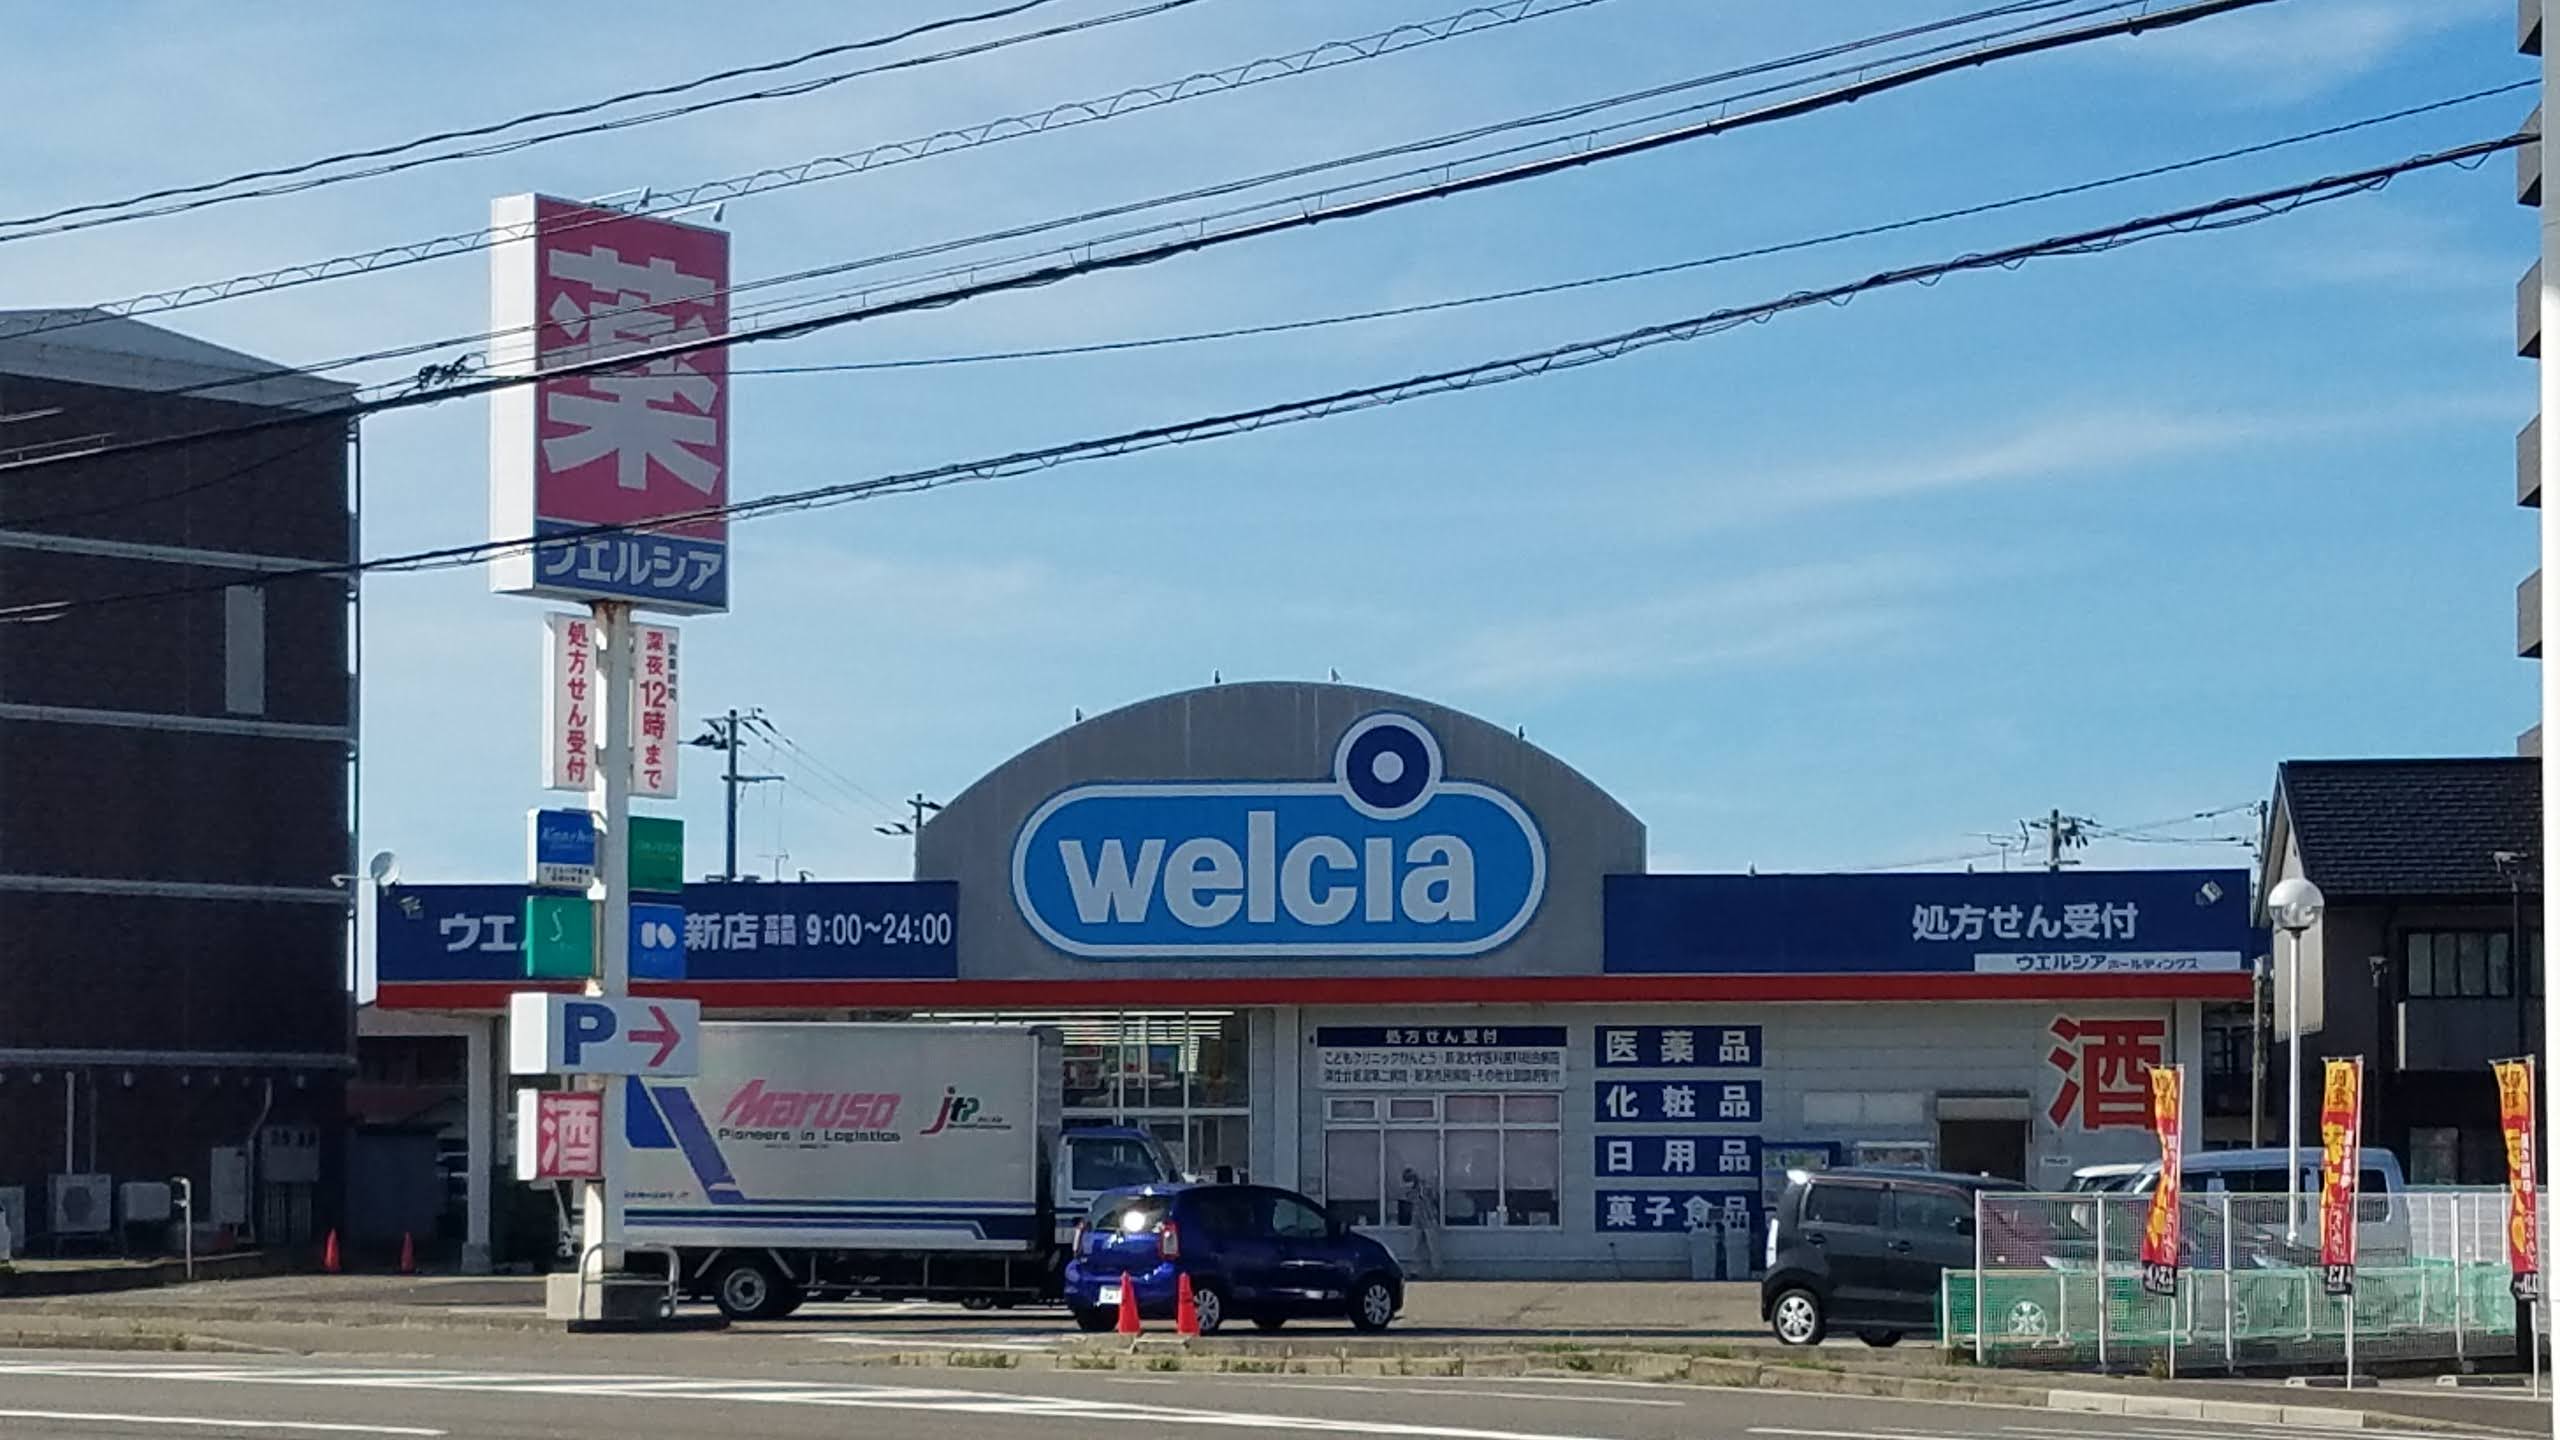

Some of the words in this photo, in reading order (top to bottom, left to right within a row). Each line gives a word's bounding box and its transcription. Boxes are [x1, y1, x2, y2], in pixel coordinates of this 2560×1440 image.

[543, 246, 721, 495] 薬
[567, 621, 589, 783] 処方せん受付
[639, 631, 668, 790] 深夜12時まで
[1058, 810, 1476, 928] welcia
[685, 912, 758, 951] 新店
[1912, 902, 2139, 942] 処方せん受付
[563, 1002, 617, 1066] P
[1385, 1028, 1498, 1045] 処方せん受付
[1606, 1030, 1750, 1063] 医薬品
[2049, 1017, 2165, 1130] 酒
[1606, 1085, 1750, 1118] 化粧品
[541, 1096, 600, 1176] 酒
[718, 1128, 790, 1142] Pioneers
[800, 1129, 815, 1141] in
[824, 1129, 901, 1143] Logistics
[1607, 1140, 1750, 1173] 日用品
[1606, 1195, 1750, 1229] 菓子食品
